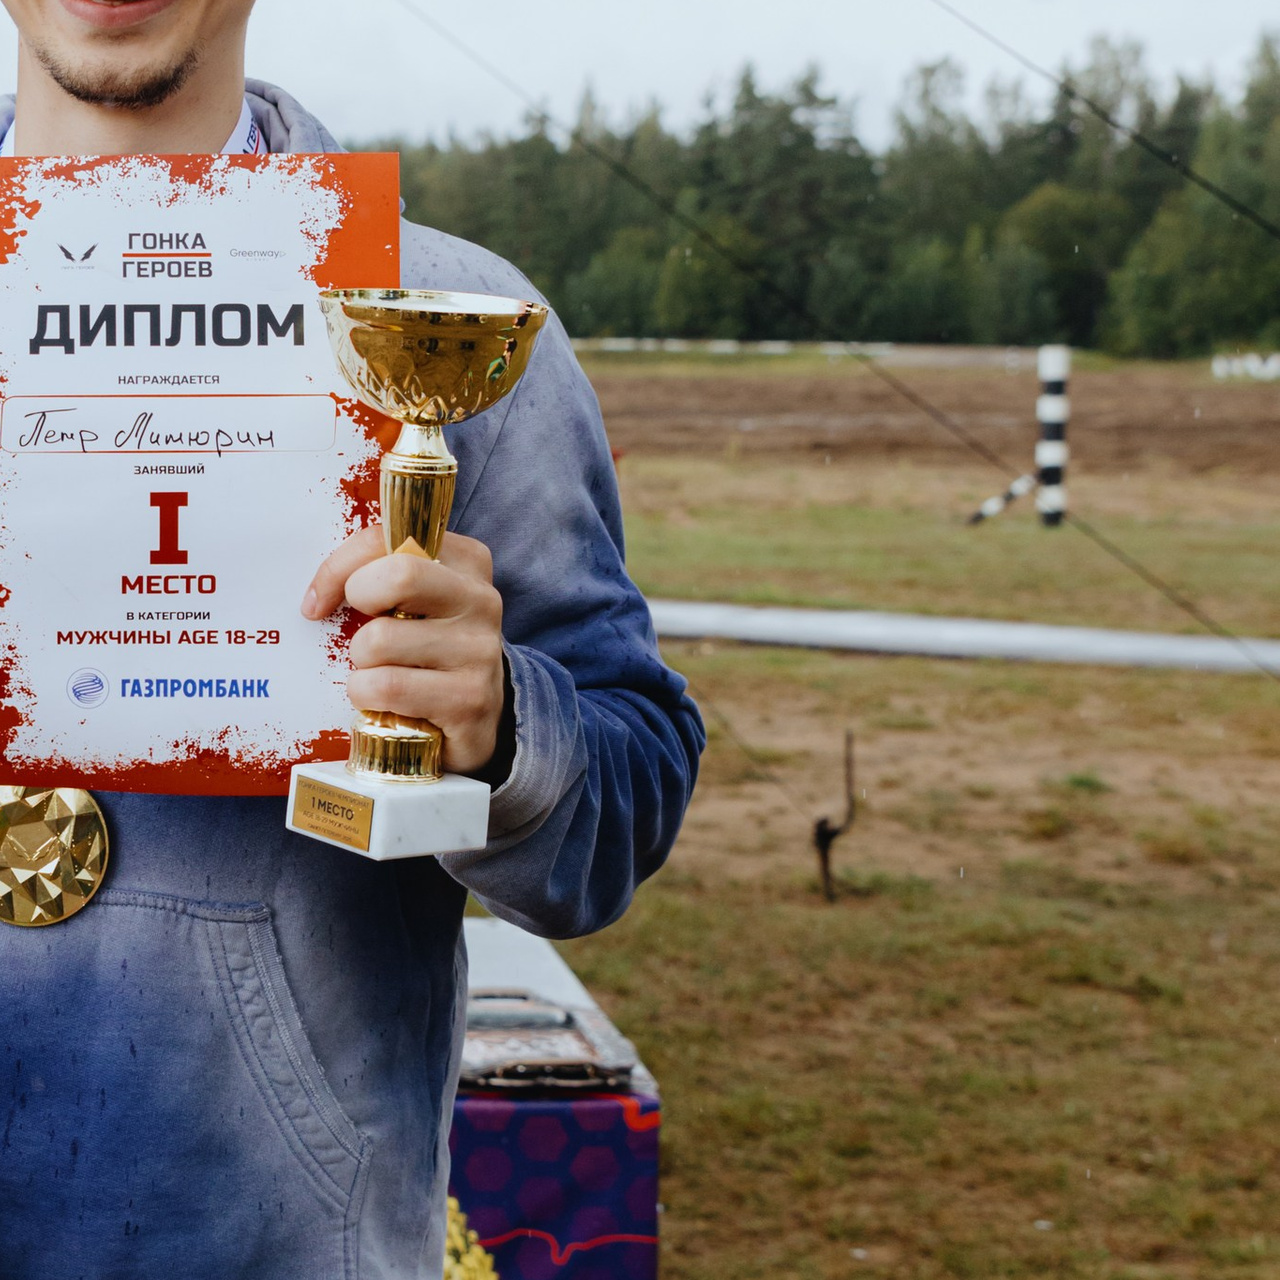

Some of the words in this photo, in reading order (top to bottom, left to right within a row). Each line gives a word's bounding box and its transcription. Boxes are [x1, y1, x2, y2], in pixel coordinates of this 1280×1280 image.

[128, 232, 207, 250] ГОНКА
[229, 248, 280, 260] Greenway
[122, 261, 213, 278] ГЕРОЕВ
[29, 303, 305, 355] ДИПЛОМ
[118, 375, 220, 386] НАГРАЖДАЕТСЯ
[133, 462, 205, 475] ЗАНЯВШИЙ
[150, 492, 188, 565] I
[121, 574, 216, 595] МЕСТО
[126, 612, 135, 621] В
[138, 611, 211, 621] КАТЕГОРИИ
[56, 630, 171, 645] МУЖЧИНЫ
[177, 630, 219, 645] AGE
[225, 629, 281, 645] 18-29
[120, 678, 270, 699] ГАЗПРОМБАНК
[311, 796, 316, 809] 1
[317, 798, 355, 821] МЕСТО
